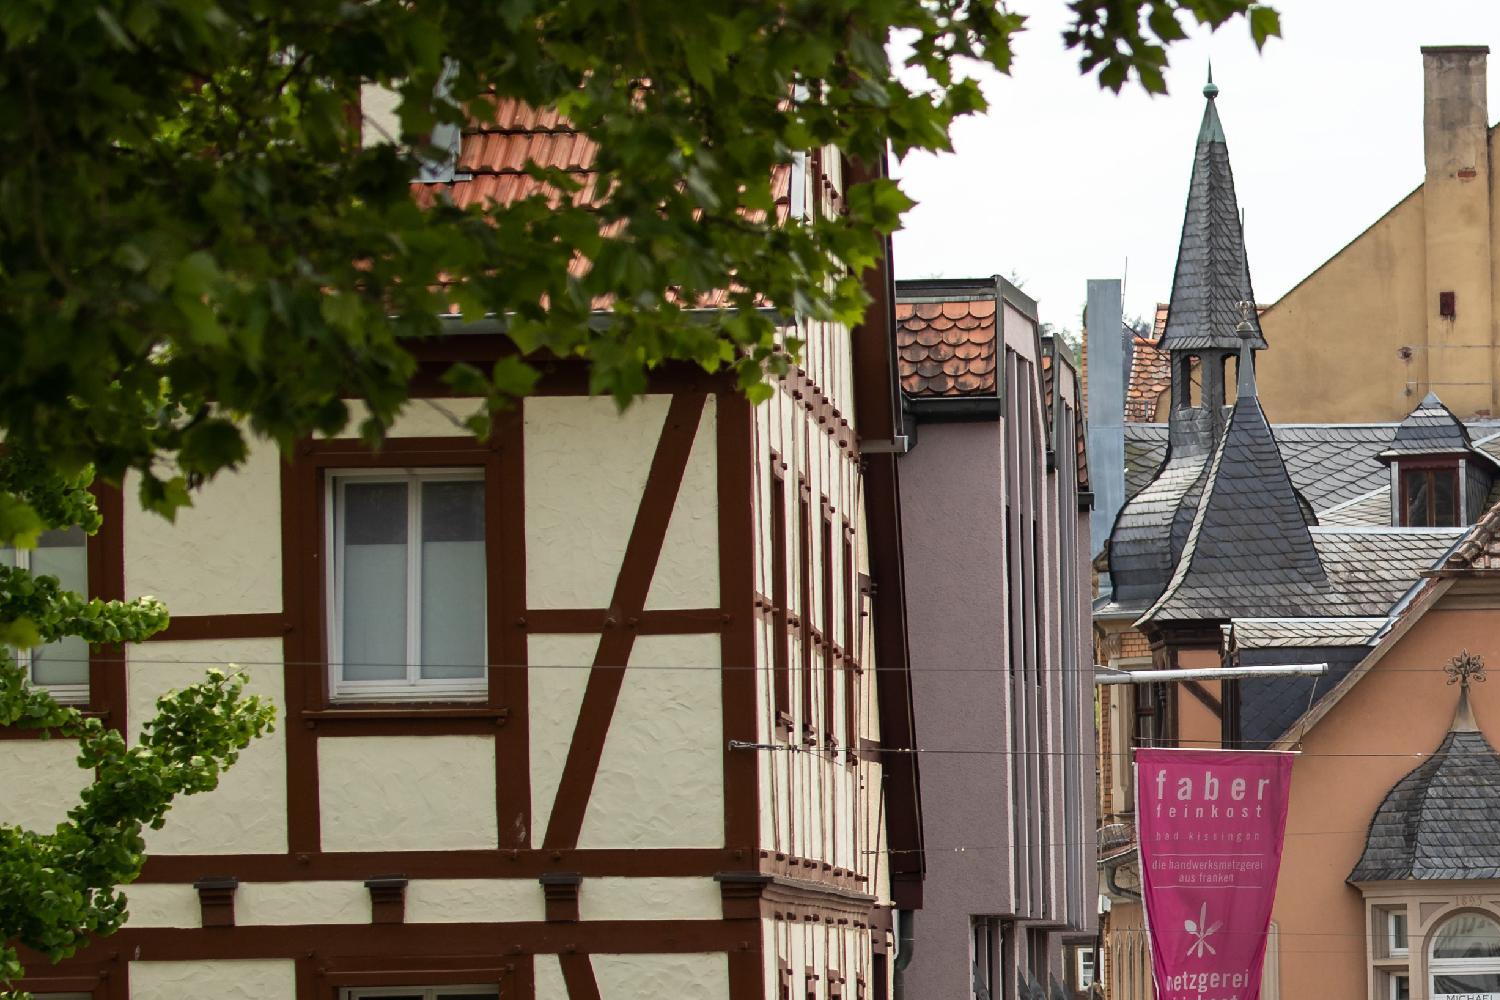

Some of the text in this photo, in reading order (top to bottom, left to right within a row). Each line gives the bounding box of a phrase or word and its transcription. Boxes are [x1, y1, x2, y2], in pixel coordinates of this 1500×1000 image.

[1155, 769, 1270, 801] faber
[1156, 803, 1262, 818] feinkost
[1156, 831, 1260, 843] bad kissingen
[1152, 859, 1263, 873] die handwerksmetzgerei
[1178, 872, 1234, 883] aus franken
